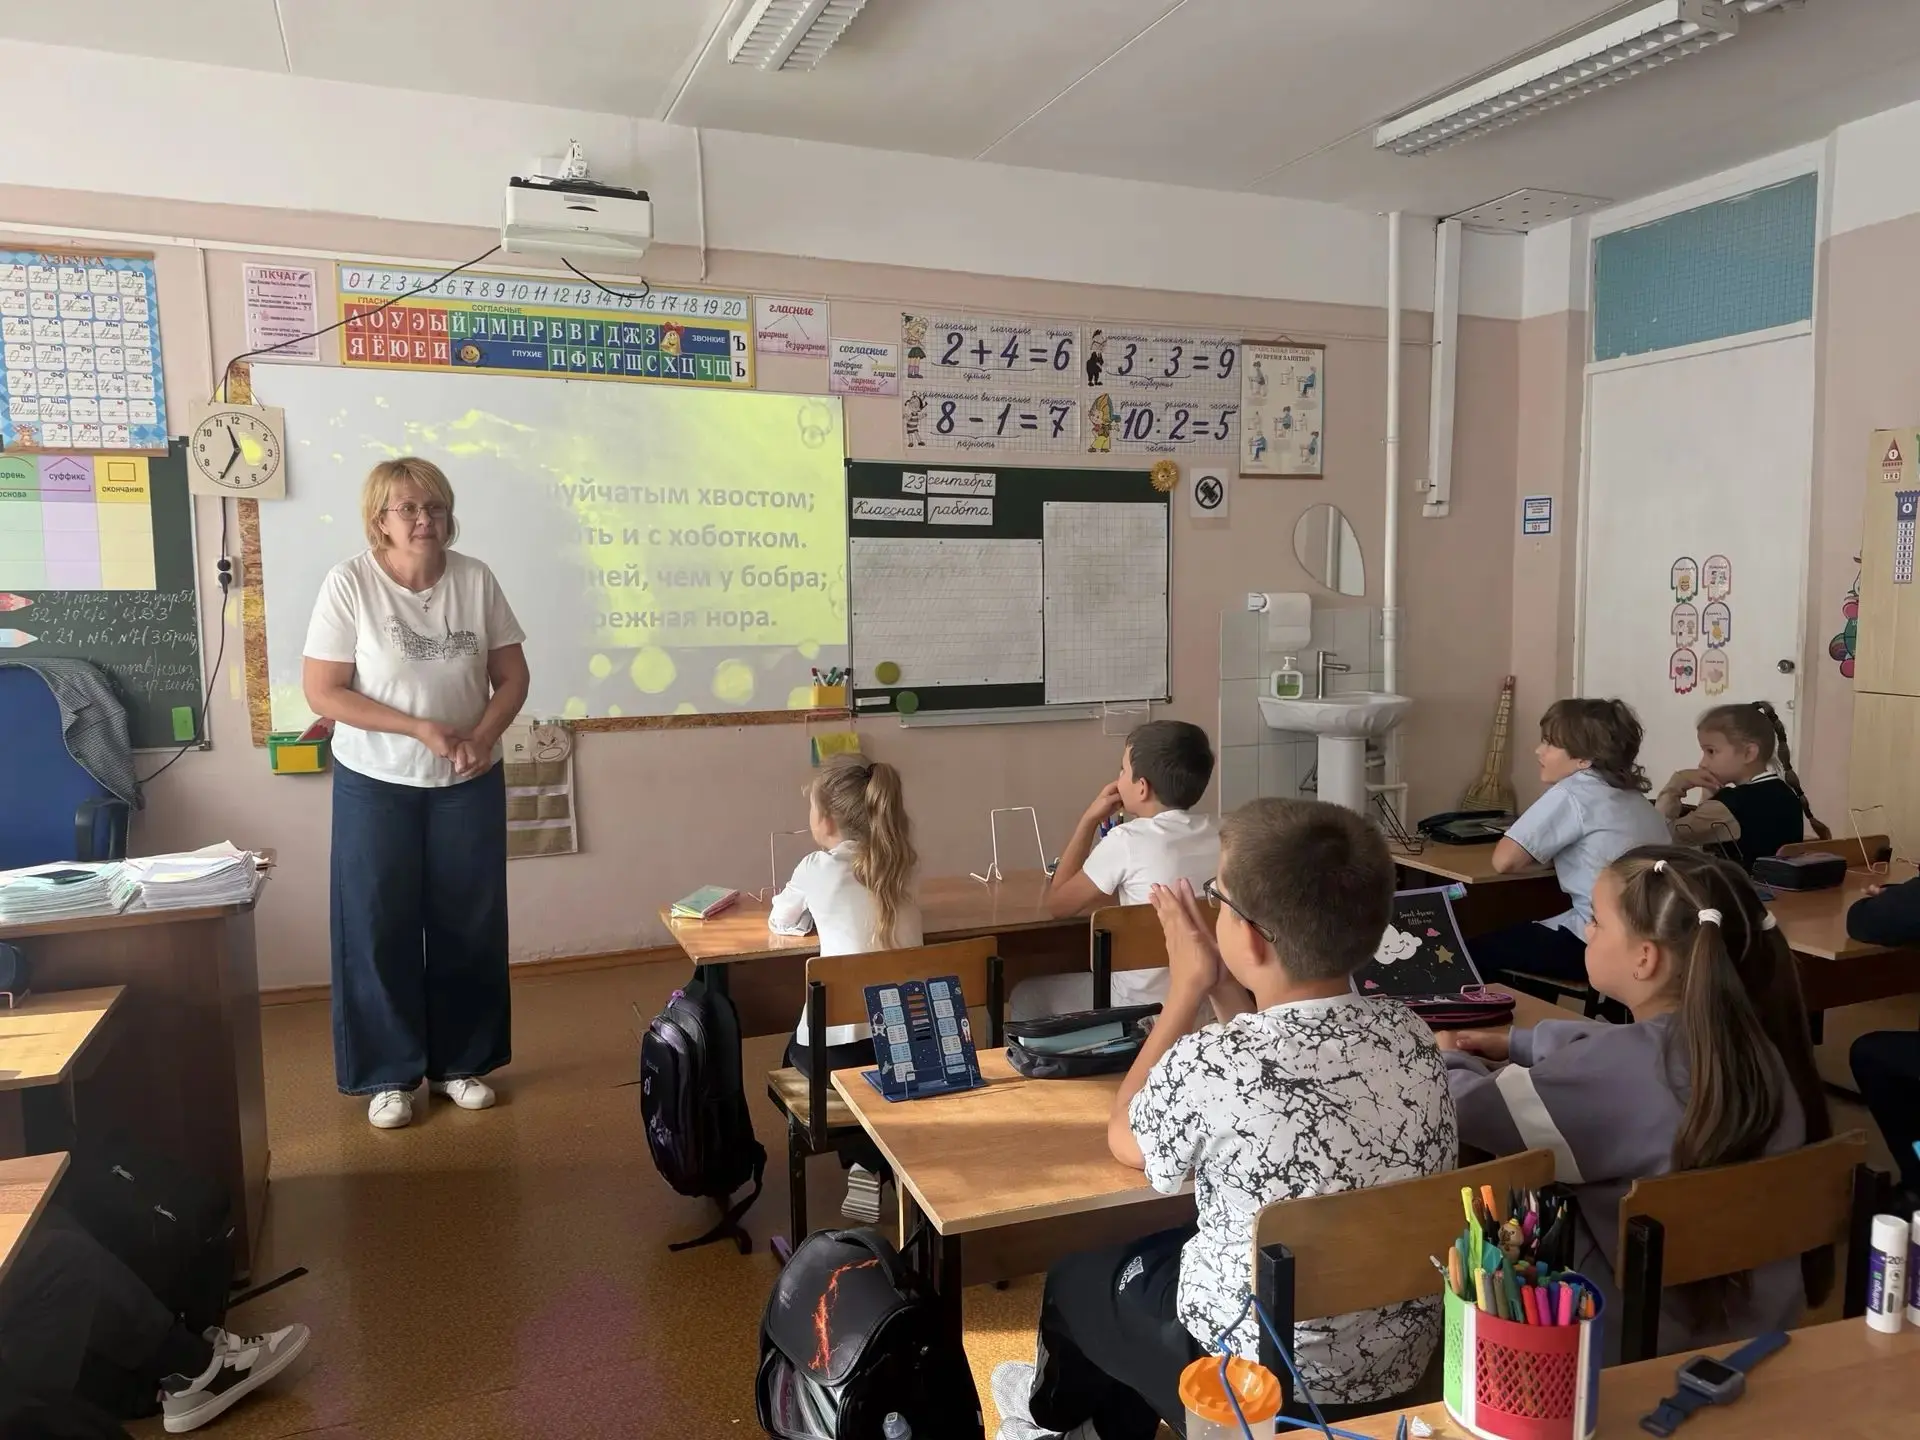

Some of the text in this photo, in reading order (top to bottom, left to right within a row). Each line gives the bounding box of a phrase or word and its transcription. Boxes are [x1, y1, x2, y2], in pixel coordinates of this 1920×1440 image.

[40, 254, 104, 266] АЗБУКА
[260, 270, 297, 280] ПКЧАГ
[348, 272, 741, 316] 0 1 2 3 4 5 6 7 8 9 10 11 12 13 14 15 16 17 18 19 20
[358, 296, 400, 306] ГЛАСНЕ
[472, 304, 522, 314] СОГЛАСНЫЕ
[769, 304, 814, 316] гласные
[348, 309, 746, 352] А О У Э Ы Й Л М Н Р Б В Г Д Ж З ЗВОНКИЕ Ъ
[758, 330, 788, 340] ударные
[785, 340, 826, 351] безударные
[840, 345, 888, 356] согласные
[941, 332, 964, 366] 2
[1000, 335, 1019, 368] 4
[1053, 338, 1073, 371] 6
[350, 336, 746, 380] Я Ё Ю Е И ГЛУХИЕ П Ф К Т Ш С Х Ц Ч Щ Ь
[1118, 344, 1137, 376] 3
[1164, 346, 1182, 378] 3
[1217, 348, 1235, 378] 9
[216, 419, 222, 428] 11
[230, 416, 240, 425] 12
[936, 400, 956, 434] 8
[997, 404, 1011, 435] 1
[1050, 406, 1070, 438] 7
[1123, 408, 1154, 440] 10
[1168, 409, 1190, 440] 2
[1214, 410, 1236, 440] 5
[203, 429, 212, 437] 10
[0, 472, 26, 480] орень
[49, 473, 86, 482] суффикс
[904, 475, 925, 490] 23
[698, 486, 816, 512] хвостом;
[854, 500, 923, 516] Классная
[623, 528, 639, 546] и
[648, 528, 661, 546] с
[668, 524, 808, 549] хоботком.
[656, 568, 712, 588] чем
[719, 569, 735, 592] у
[740, 564, 828, 592] бобра;
[706, 609, 778, 632] нора.
[1872, 1280, 1882, 1310] berlingo
